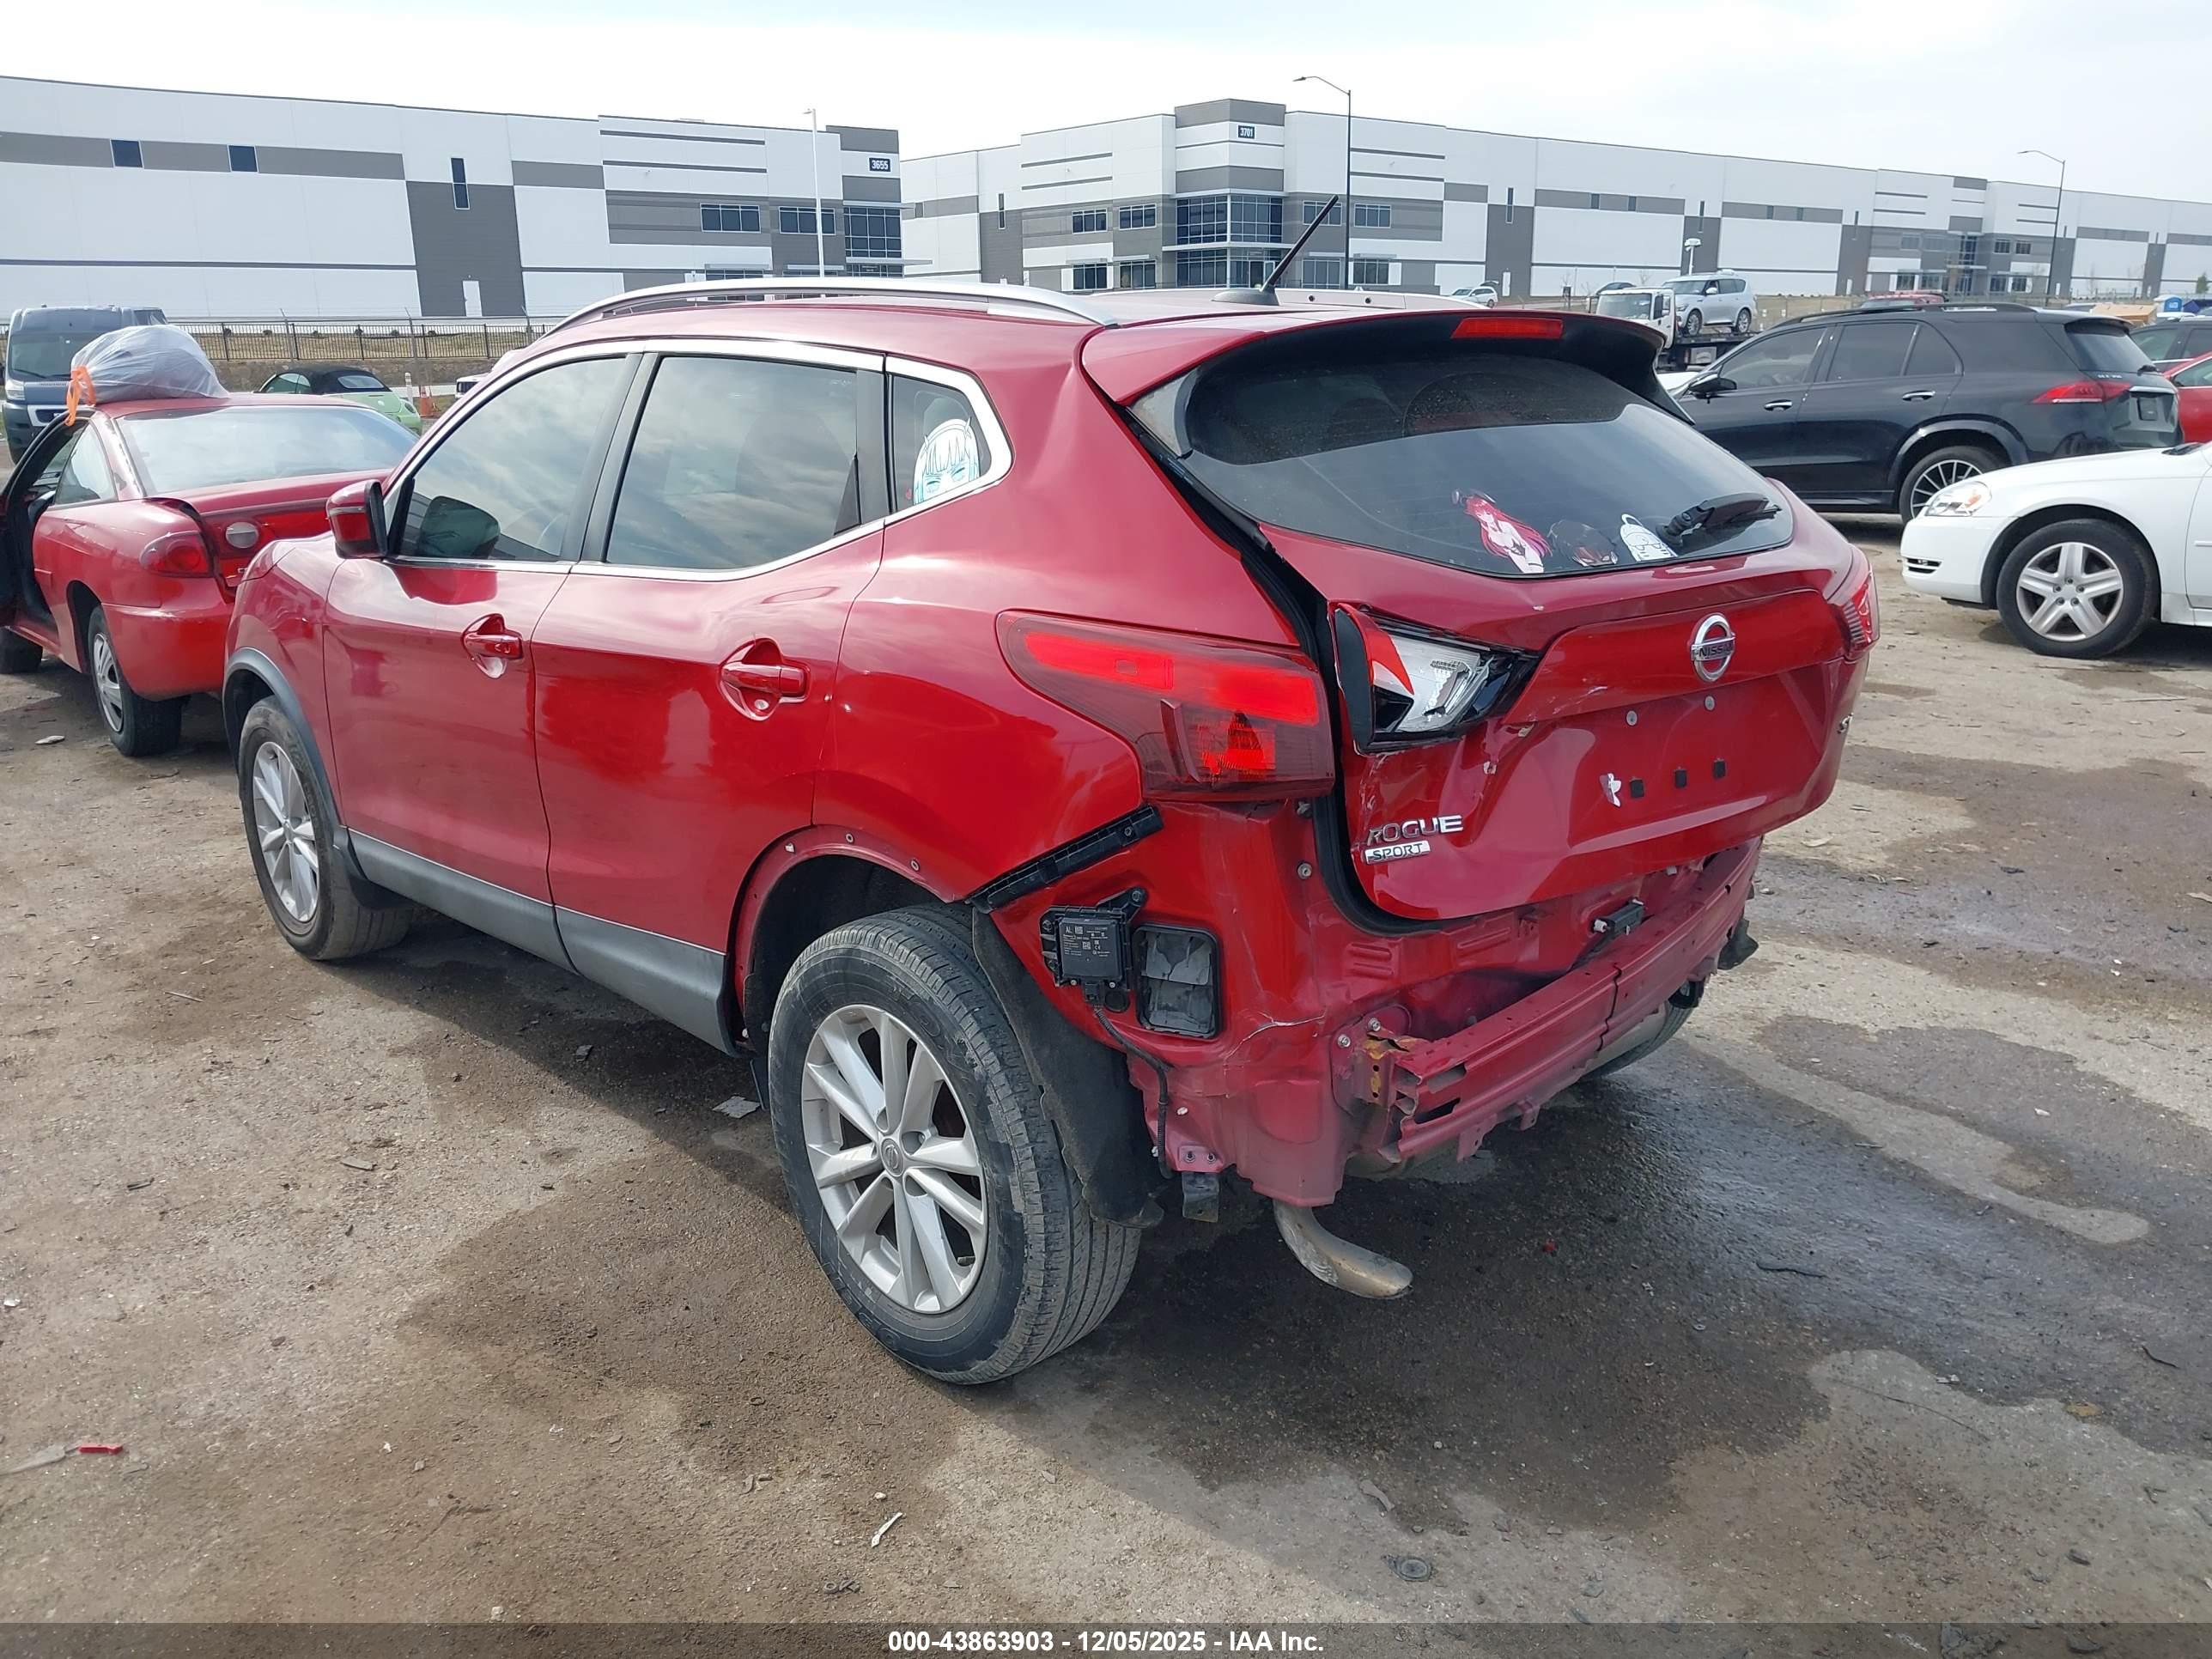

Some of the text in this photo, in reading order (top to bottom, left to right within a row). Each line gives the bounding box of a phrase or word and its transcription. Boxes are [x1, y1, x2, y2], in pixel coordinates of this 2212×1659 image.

[1240, 127, 1254, 137] 3701
[872, 160, 889, 170] 3655
[1366, 815, 1463, 847] ROGUE
[1372, 842, 1423, 861] SPORT
